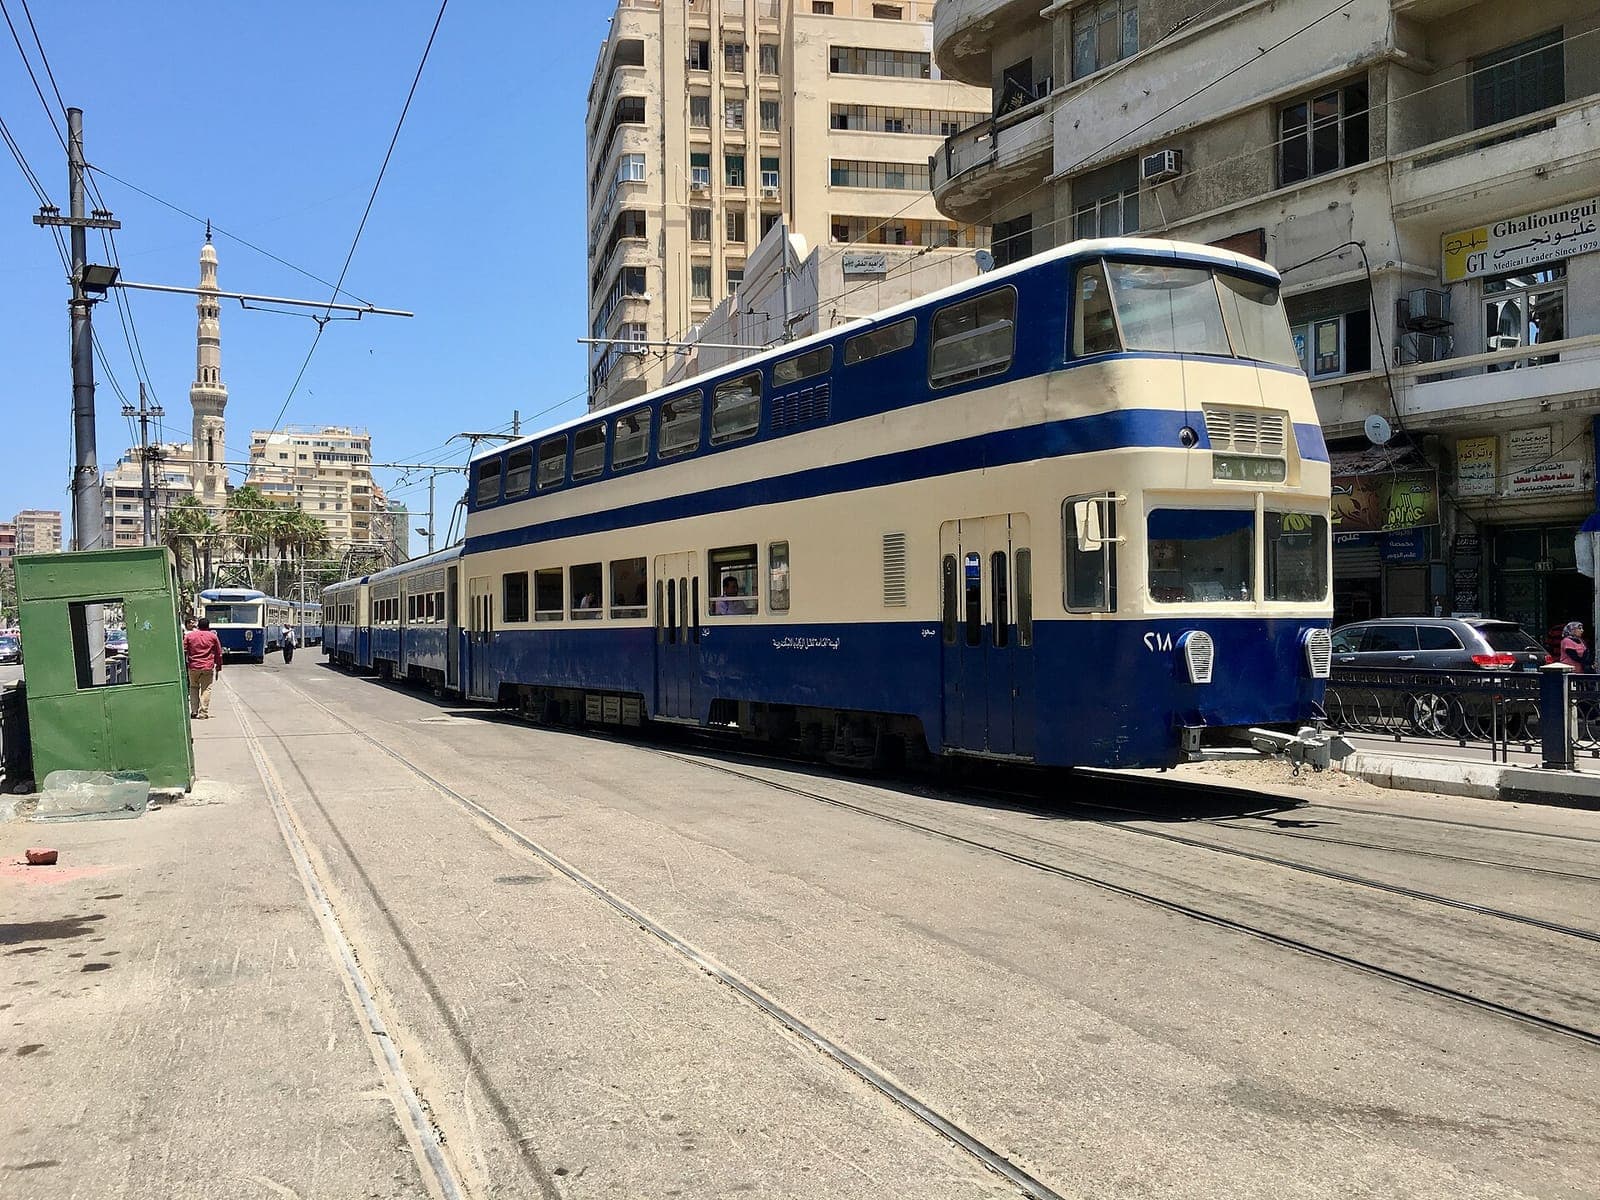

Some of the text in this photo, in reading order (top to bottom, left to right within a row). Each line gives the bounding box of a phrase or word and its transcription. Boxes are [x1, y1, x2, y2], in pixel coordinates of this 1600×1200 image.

[1493, 200, 1597, 238] Ghalioungui
[1466, 252, 1488, 274] GT
[1494, 241, 1598, 271] Medical Leader Since 1979
[921, 628, 936, 638] صعود
[1143, 632, 1173, 652] ٢١٨
